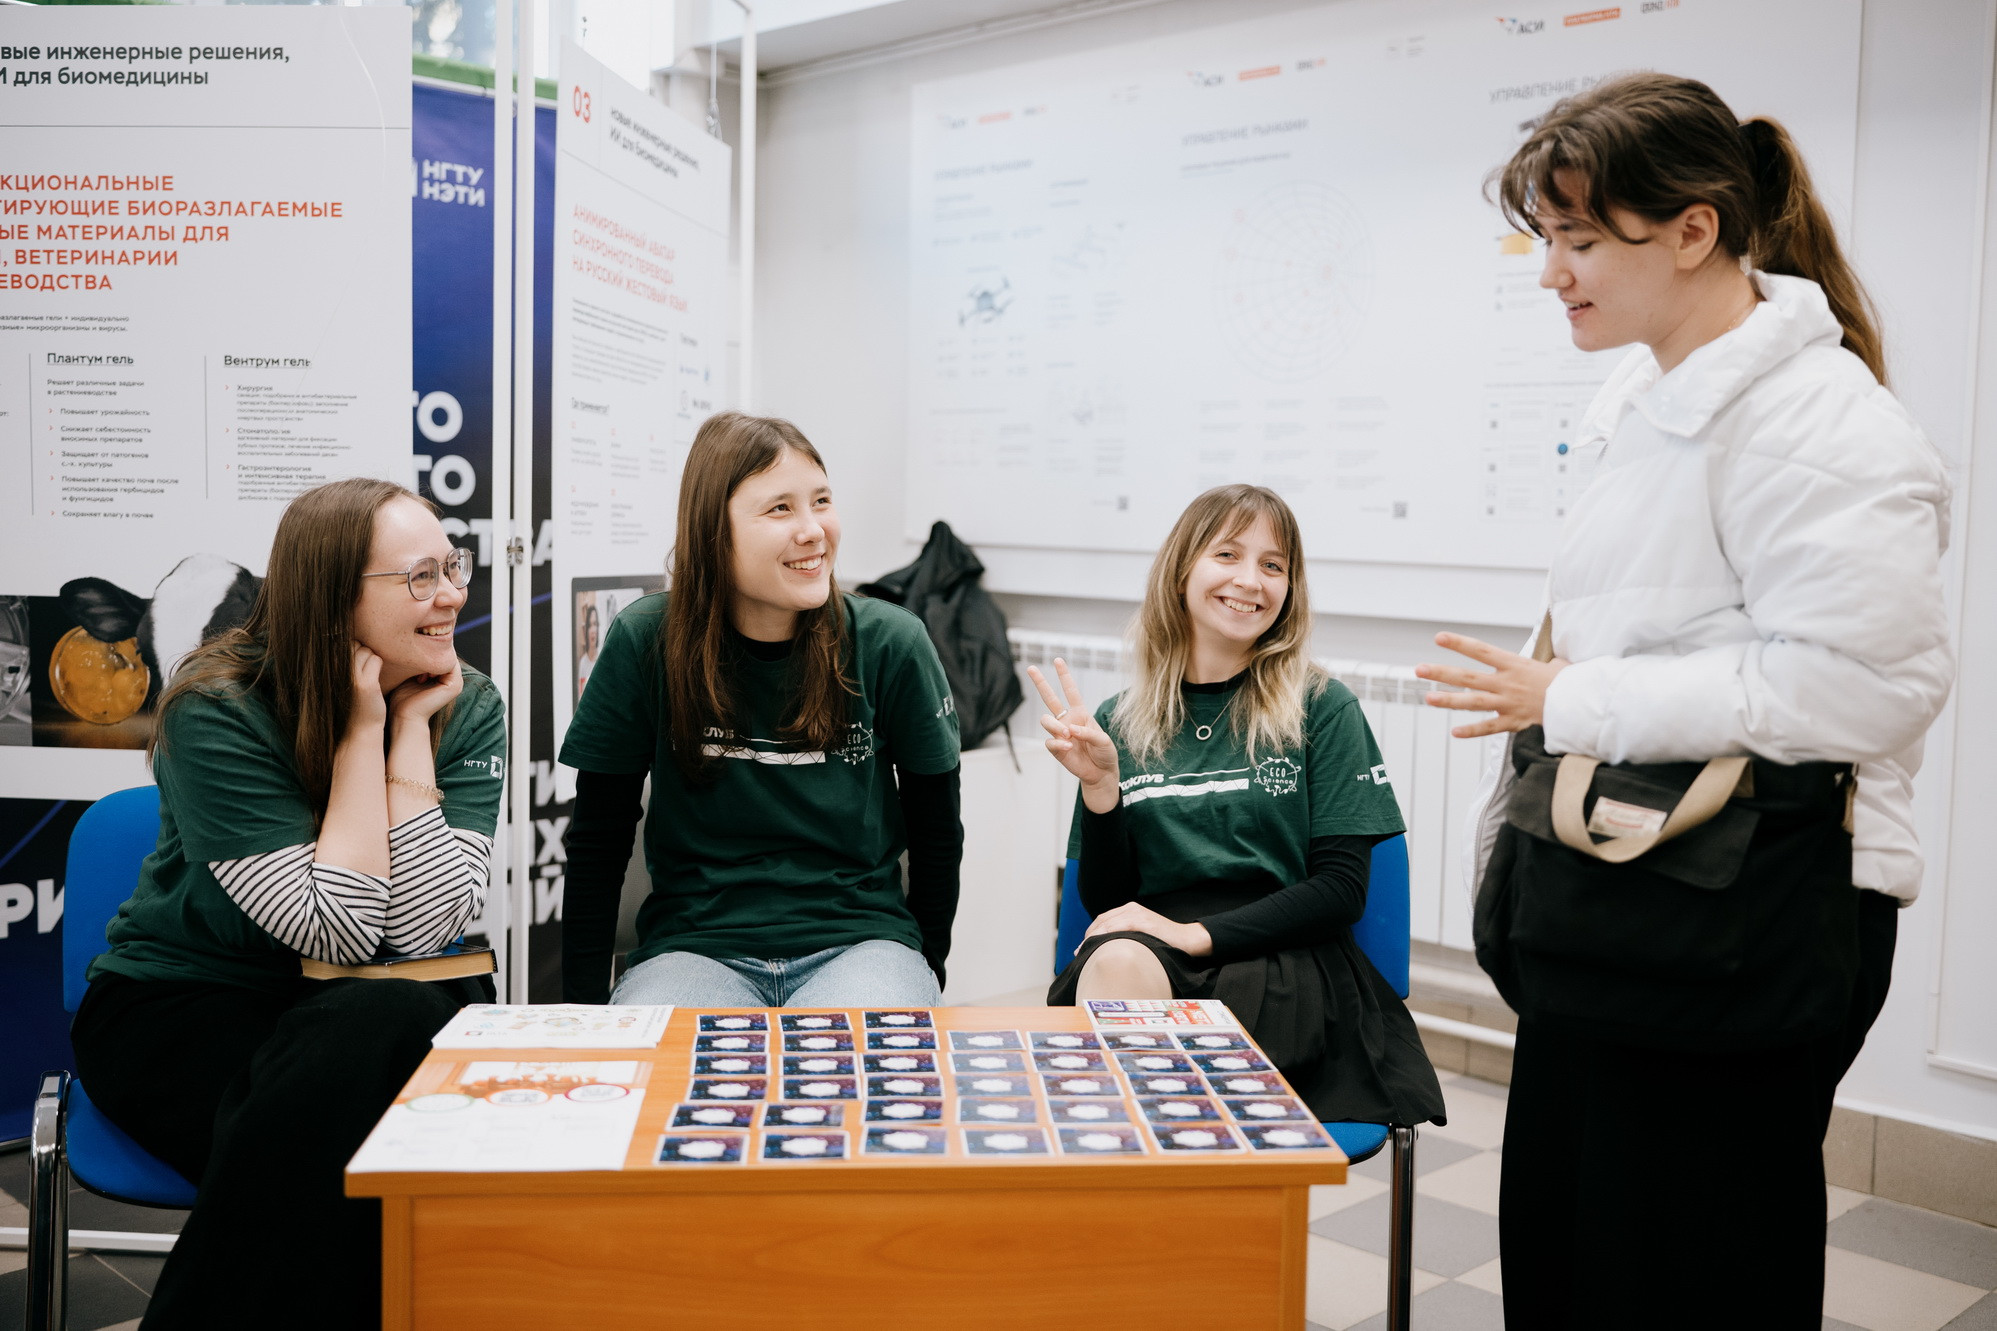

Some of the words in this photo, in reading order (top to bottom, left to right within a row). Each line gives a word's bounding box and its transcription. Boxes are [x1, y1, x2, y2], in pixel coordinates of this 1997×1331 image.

[1, 46, 41, 60] вые
[46, 46, 183, 63] инженерные
[189, 46, 291, 63] решения,
[13, 71, 52, 87] для
[57, 66, 209, 87] биомедицины
[573, 85, 591, 123] 03
[422, 159, 484, 186] НГТУ
[0, 174, 174, 192] КЦИОНАЛЬНЫЕ
[422, 180, 485, 207] НЭТИ
[0, 199, 119, 217] ИРУЮЩИЕ
[127, 200, 343, 218] БИОРАЗЛАГАЕМЫЕ
[37, 225, 174, 241] МАТЕРИАЛЫ
[183, 226, 229, 243] ДЛЯ
[15, 249, 178, 266] ВЕТЕРИНАРИИ
[47, 353, 103, 366] Плантум
[106, 355, 135, 364] гель
[224, 355, 280, 368] Вентрум
[101, 409, 151, 417] урожайность
[62, 510, 101, 518] Сохраняет
[463, 759, 488, 769] НГТУ
[1269, 767, 1286, 777] ECO
